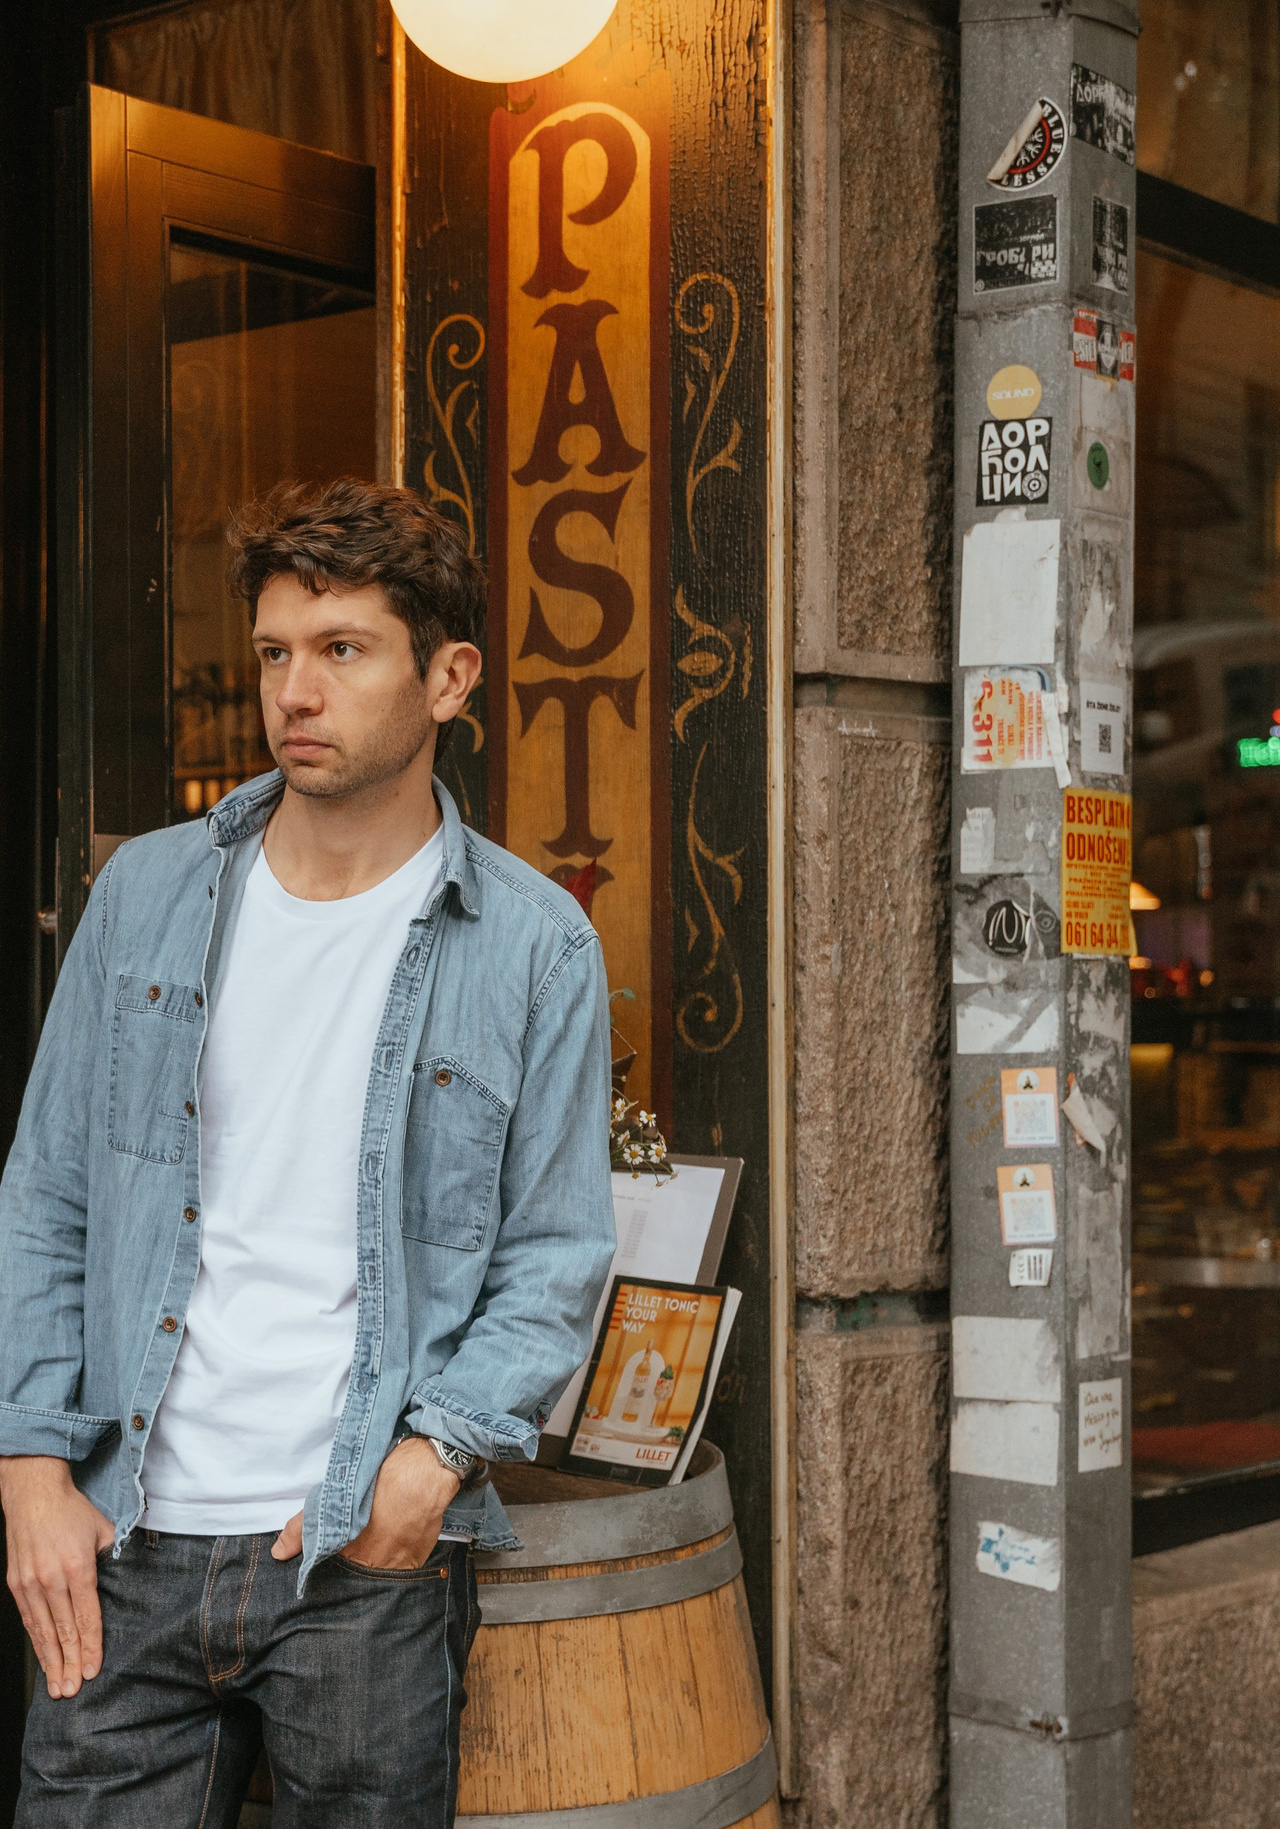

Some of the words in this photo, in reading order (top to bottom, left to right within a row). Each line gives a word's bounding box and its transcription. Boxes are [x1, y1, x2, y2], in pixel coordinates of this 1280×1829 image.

[992, 388, 1036, 401] SOUND
[511, 110, 647, 922] PAST
[628, 1293, 662, 1309] LILLET
[664, 1297, 700, 1314] TONIC
[626, 1306, 658, 1322] YOUR
[622, 1319, 646, 1334] WAY
[636, 1447, 672, 1462] LILLET
